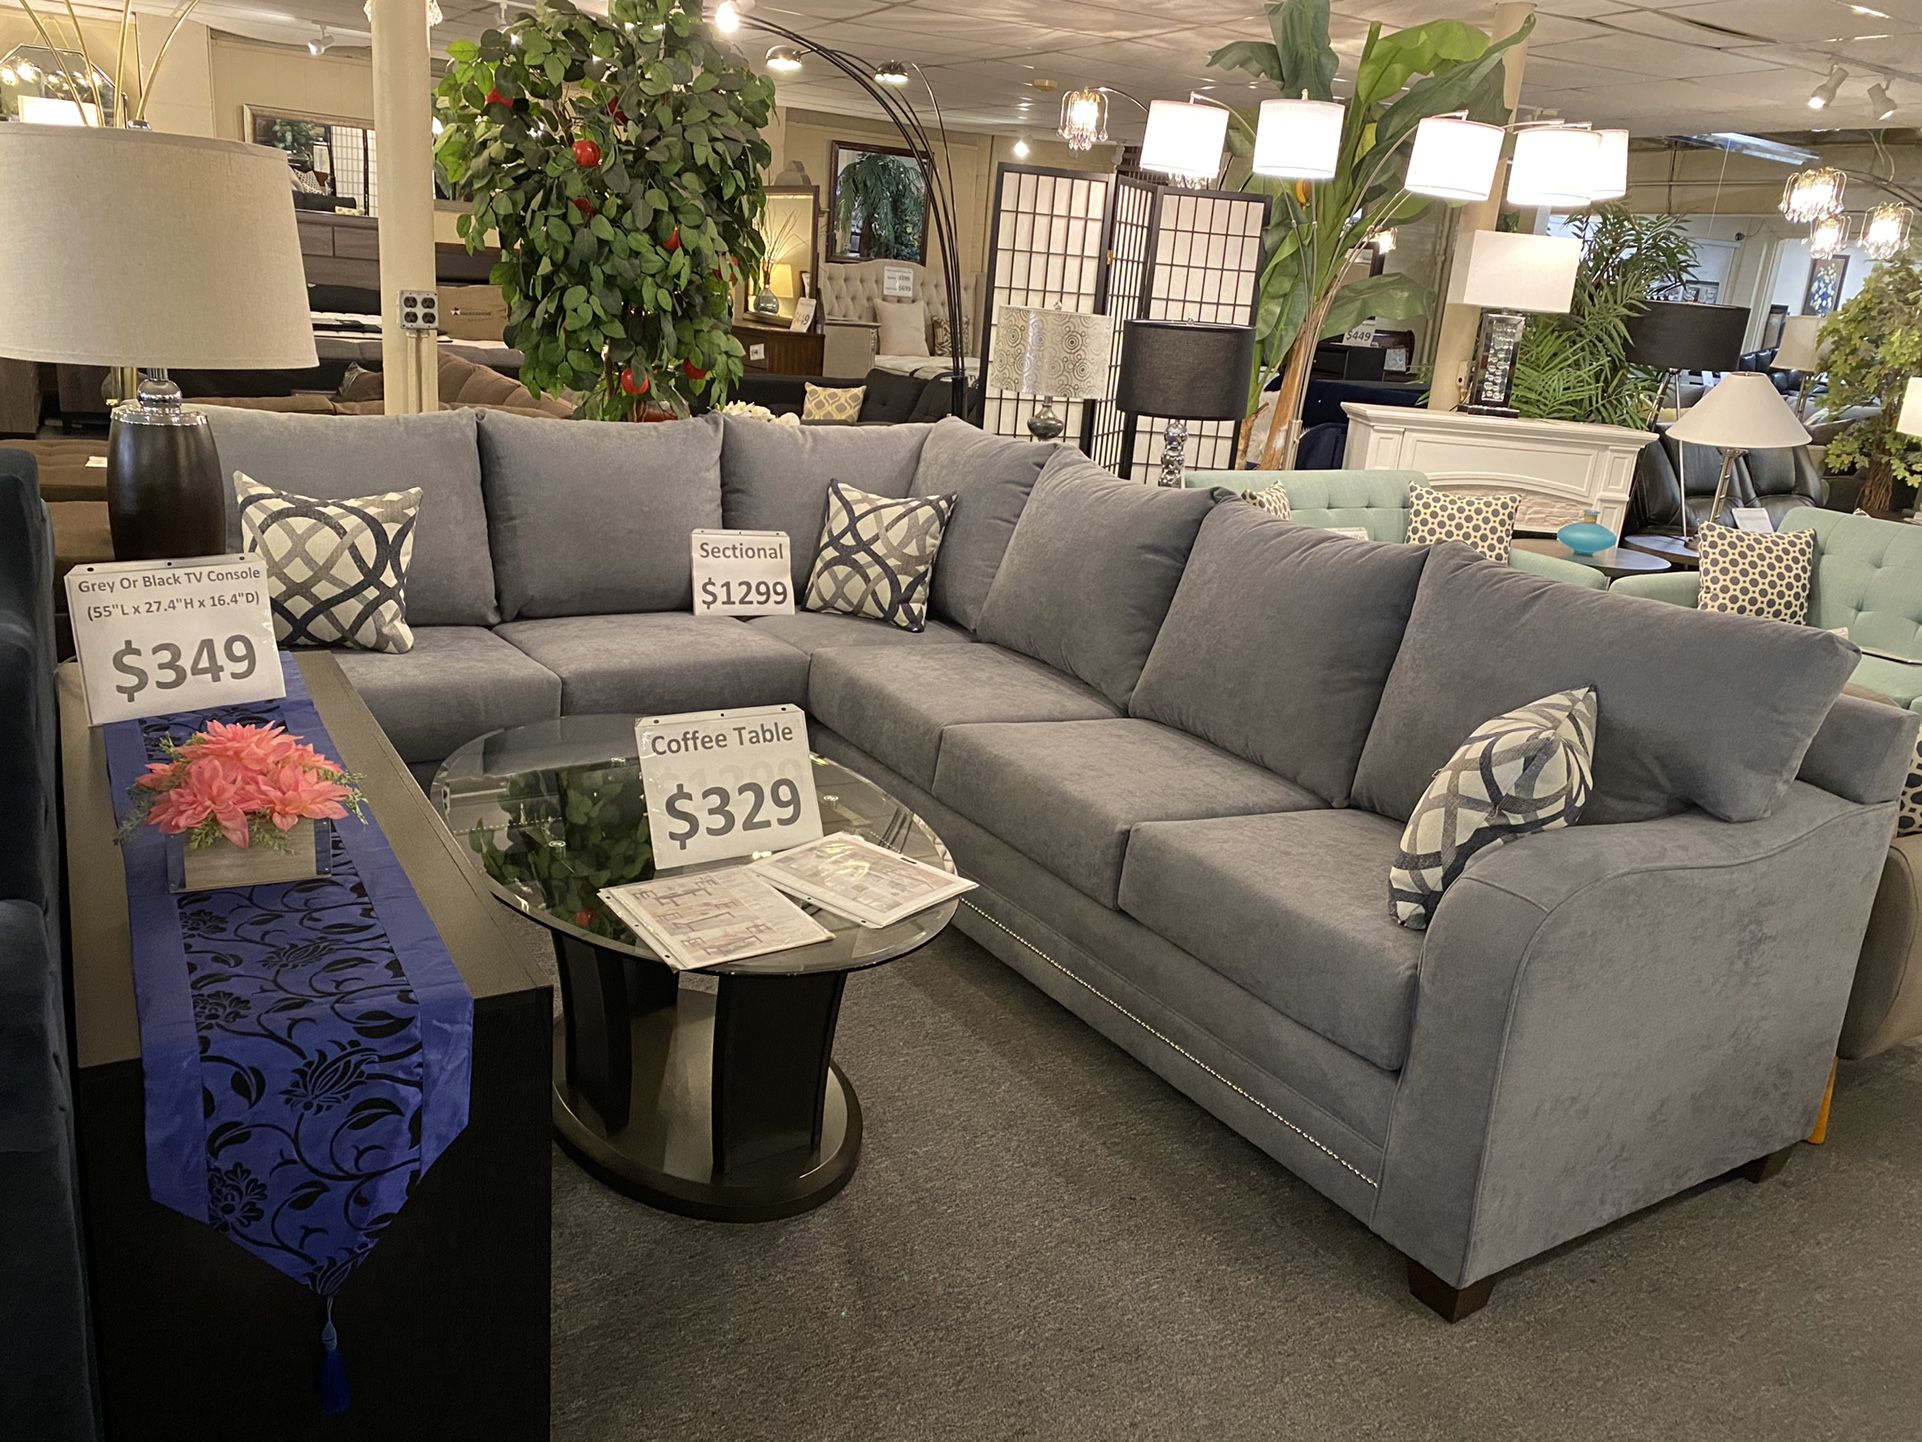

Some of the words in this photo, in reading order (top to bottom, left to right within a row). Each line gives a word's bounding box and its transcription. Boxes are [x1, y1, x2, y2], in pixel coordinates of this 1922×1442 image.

[1346, 330, 1371, 341] $449
[700, 542, 784, 560] Sectional
[78, 580, 115, 594] Grey
[119, 577, 138, 590] Or
[142, 574, 182, 588] Black
[184, 571, 203, 584] TV
[207, 567, 261, 583] Console
[701, 577, 788, 610] $1299
[87, 603, 130, 622] (55"L
[132, 605, 141, 615] x
[145, 598, 195, 614] 27.4"H
[197, 599, 206, 608] x
[209, 591, 260, 608] 16.4"D)
[112, 634, 257, 703] $349
[651, 729, 728, 756] Coffee
[732, 721, 794, 746] Table
[665, 778, 802, 851] $329
